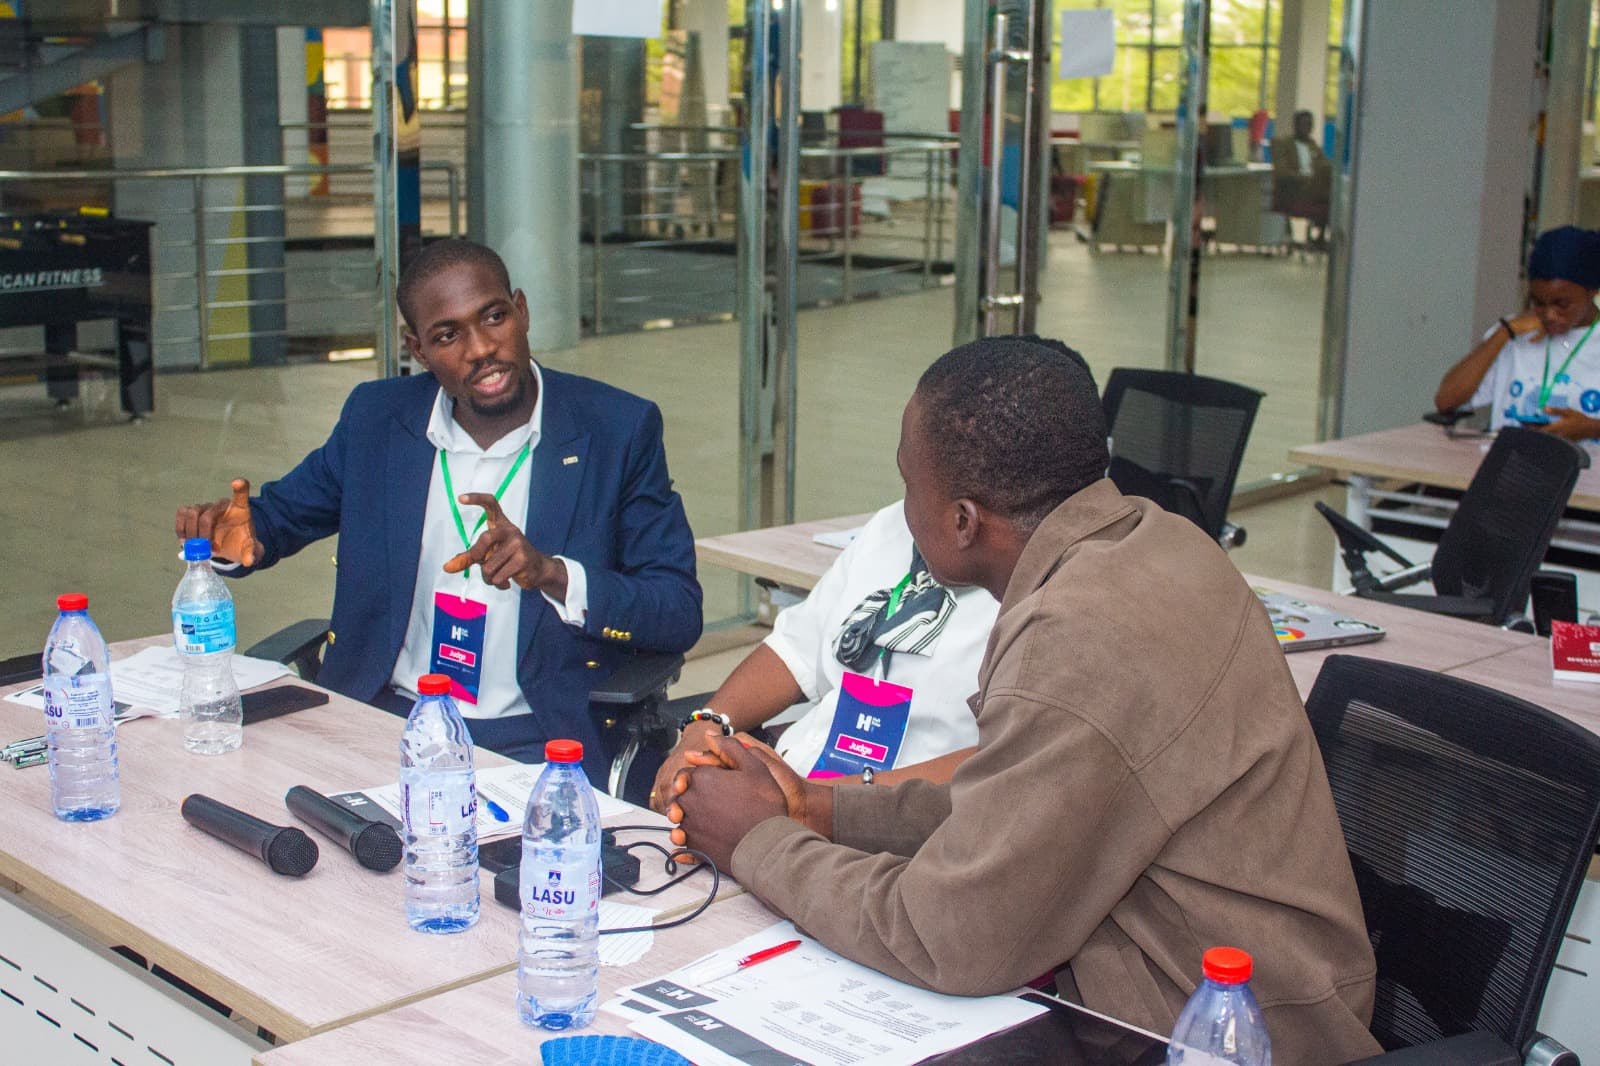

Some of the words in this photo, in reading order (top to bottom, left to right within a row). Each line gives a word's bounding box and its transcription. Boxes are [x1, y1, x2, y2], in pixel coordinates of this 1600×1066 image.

[37, 267, 102, 288] FITNESS
[856, 713, 873, 732] H
[849, 741, 873, 755] Judge
[532, 886, 575, 905] LASU
